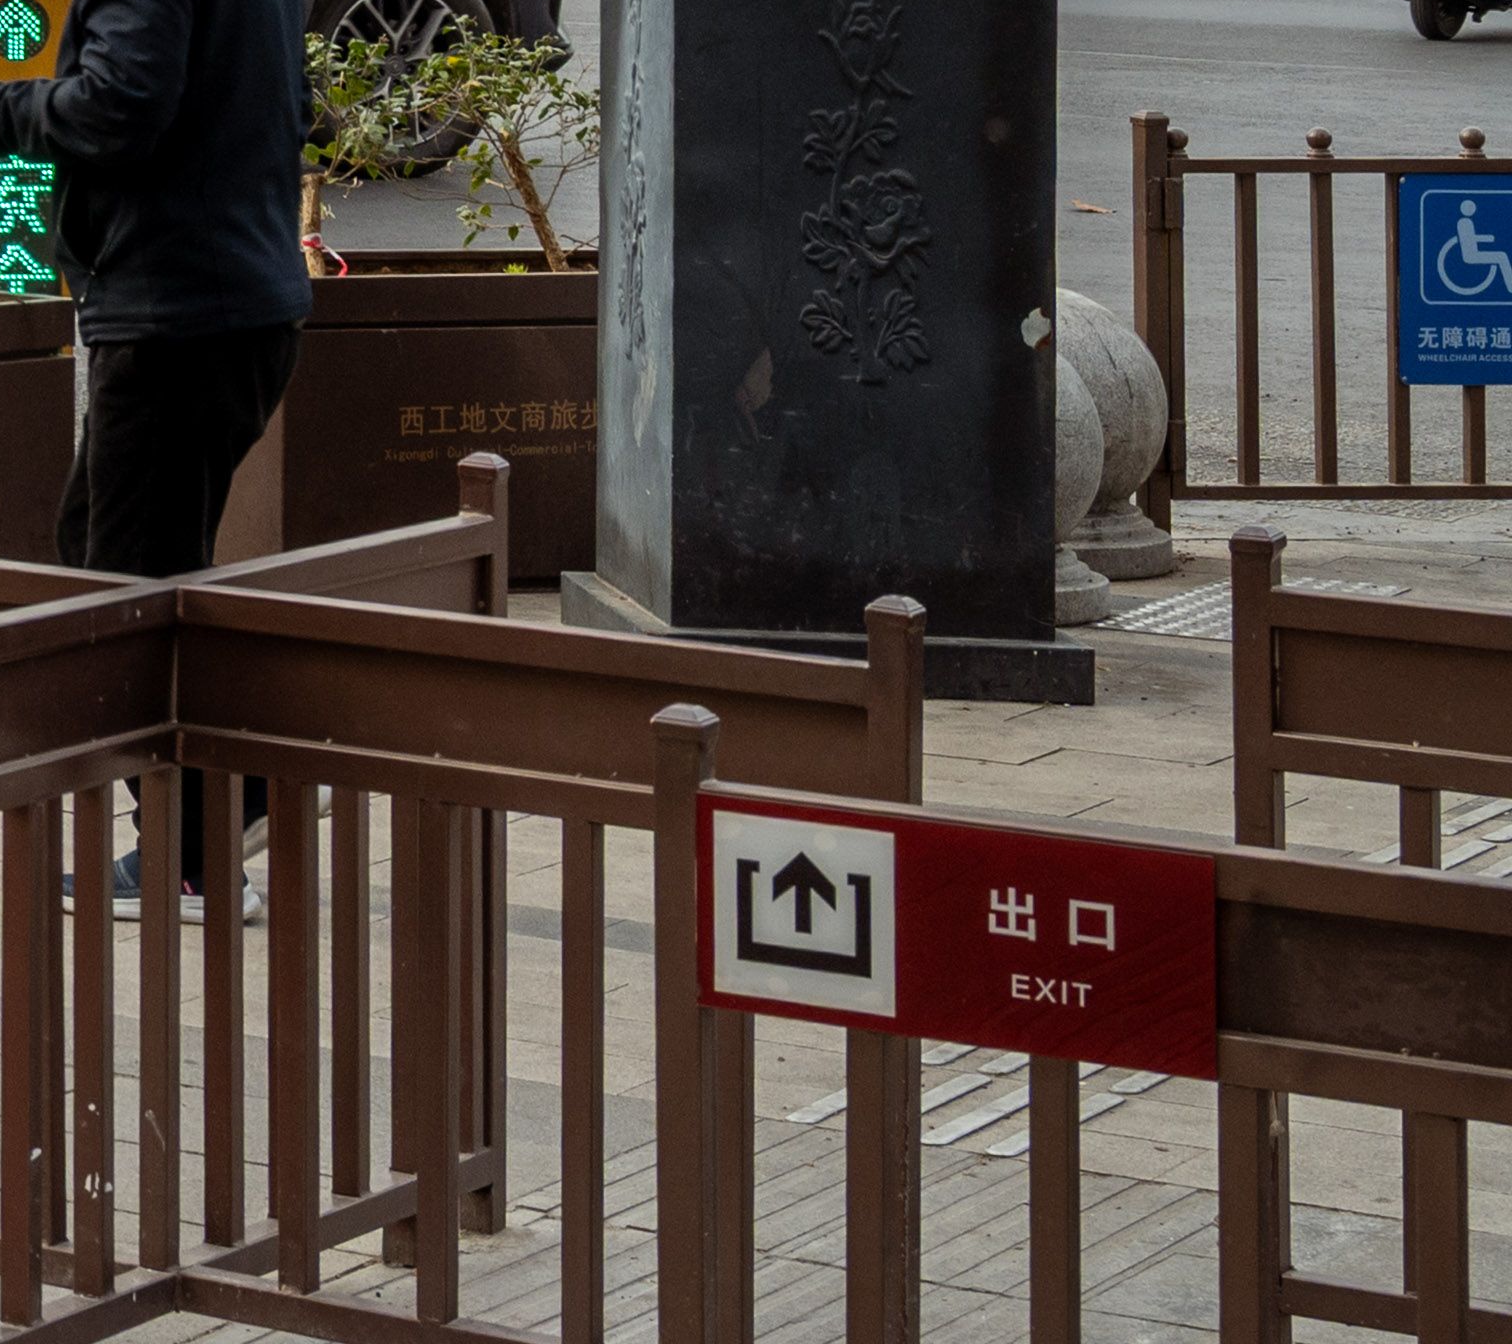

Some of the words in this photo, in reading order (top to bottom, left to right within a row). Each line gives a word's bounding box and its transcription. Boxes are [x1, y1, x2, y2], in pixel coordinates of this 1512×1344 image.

[1417, 326, 1512, 349] 无障碍通
[1417, 353, 1477, 363] WHEELCHAIR
[986, 886, 1117, 952] 出口
[1009, 972, 1094, 1010] EXIT
